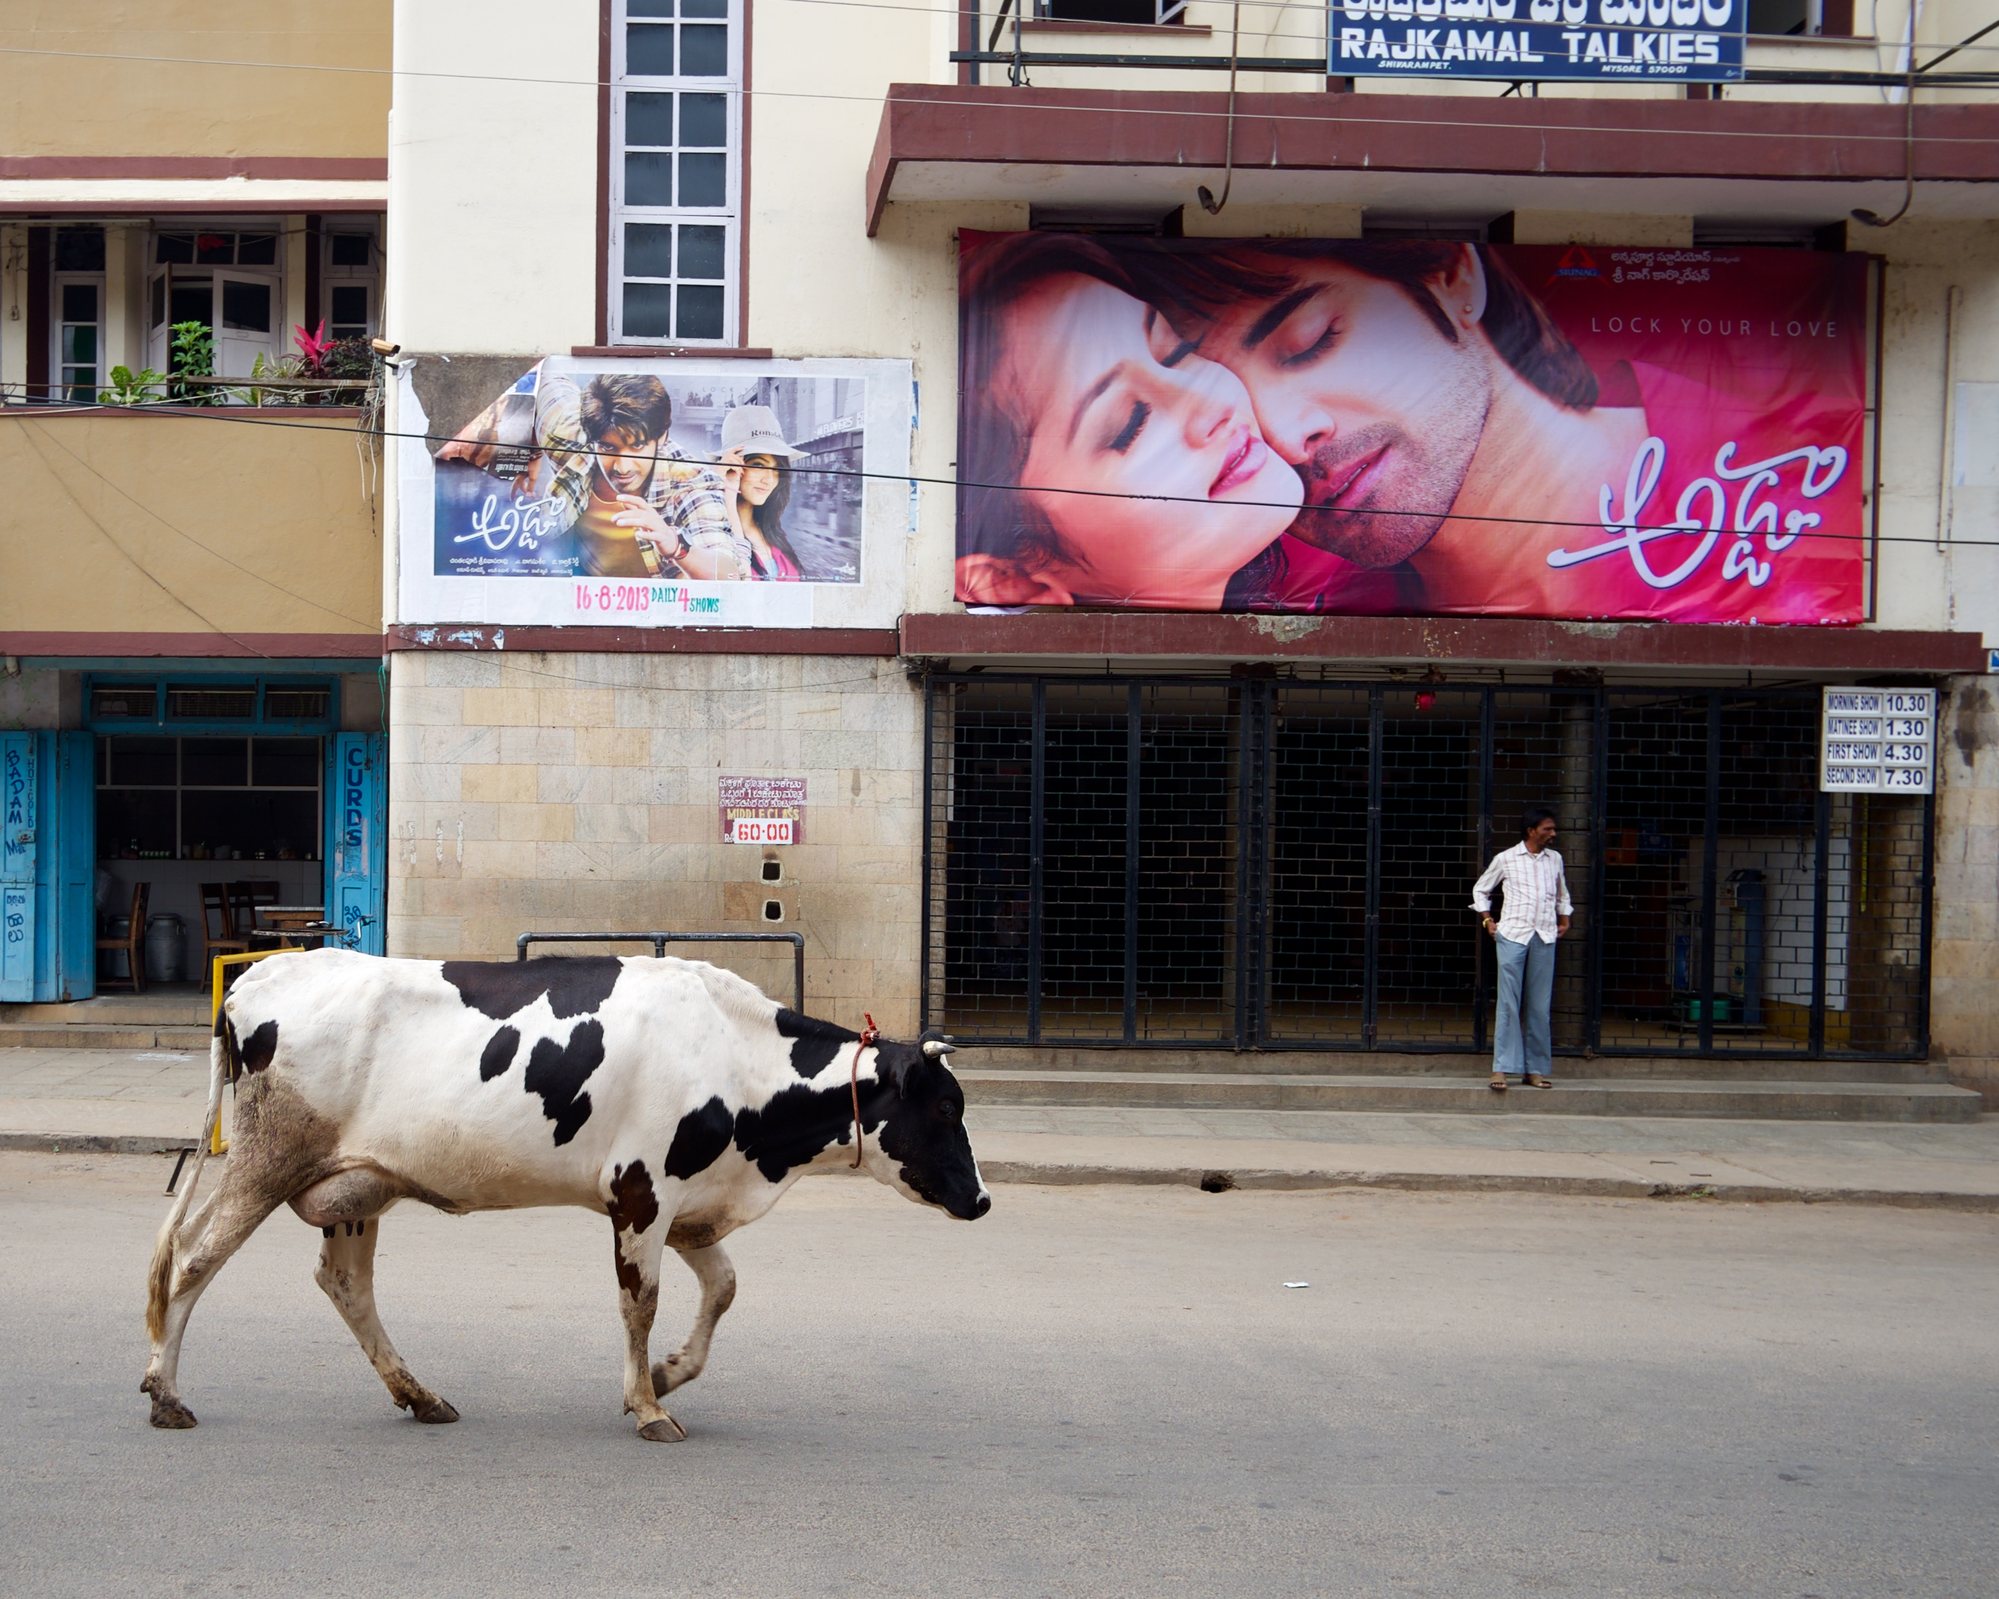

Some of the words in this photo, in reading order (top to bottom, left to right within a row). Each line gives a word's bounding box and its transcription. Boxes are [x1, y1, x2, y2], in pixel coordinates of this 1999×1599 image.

[1341, 27, 1544, 63] RAJKAMAL
[1562, 32, 1720, 65] TALKIES
[1601, 64, 1643, 73] MYSORE
[1648, 65, 1688, 74] 570001
[1591, 316, 1661, 333] LOCK
[1681, 318, 1751, 336] YOUR
[1770, 321, 1837, 338] LOVE
[651, 587, 678, 603] DAILY
[677, 587, 690, 612] 4
[689, 597, 720, 612] SHOWS
[1828, 695, 1859, 711] MORNING
[1860, 696, 1879, 711] SHOW
[1886, 695, 1926, 712] 10.30
[1828, 719, 1857, 735] MATINEE
[1858, 720, 1879, 735] SHOW
[1886, 719, 1925, 736] 1.30
[1827, 744, 1851, 759] FIRST
[1852, 745, 1878, 760] SHOW
[1885, 744, 1923, 761] 4.30
[1826, 768, 1855, 784] SECOND
[1856, 769, 1877, 784] SHOW
[1885, 769, 1924, 786] 7.30
[6, 750, 25, 825] BADAM
[346, 748, 363, 847] CURDS
[727, 808, 766, 820] MIDDLE
[767, 808, 800, 821] CLASS
